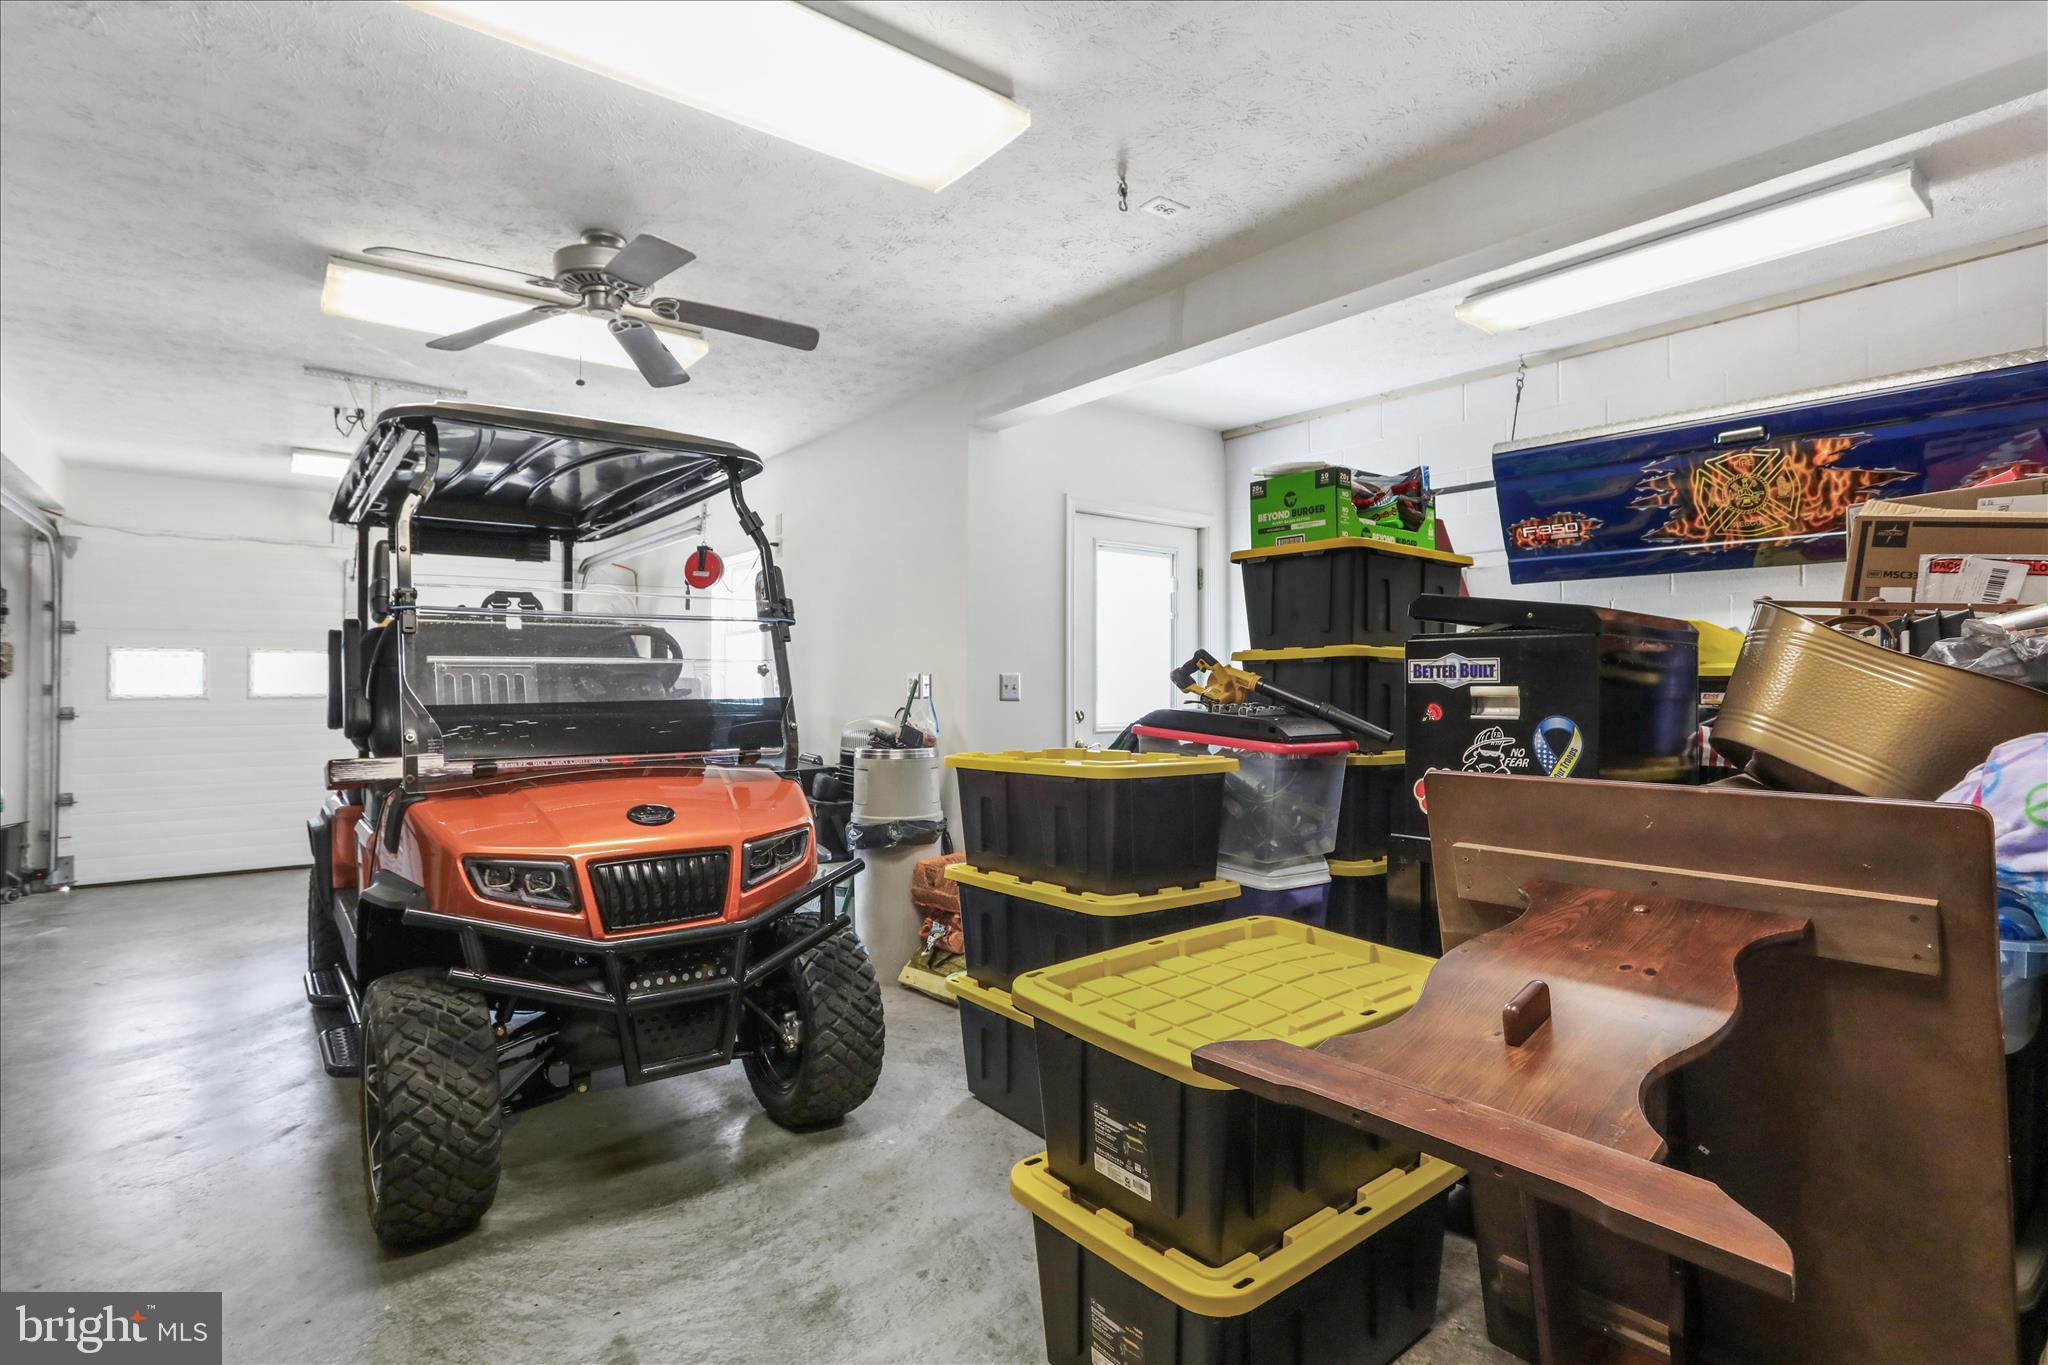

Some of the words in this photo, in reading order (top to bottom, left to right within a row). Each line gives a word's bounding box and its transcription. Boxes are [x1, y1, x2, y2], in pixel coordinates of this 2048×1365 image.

[1257, 510, 1291, 523] BEYOND
[1291, 504, 1326, 517] BURGER
[1413, 663, 1457, 679] BETTER
[1460, 662, 1497, 679] BUILT
[1510, 748, 1526, 757] NO
[1560, 747, 1578, 769] Troops
[1504, 758, 1530, 768] FEAR
